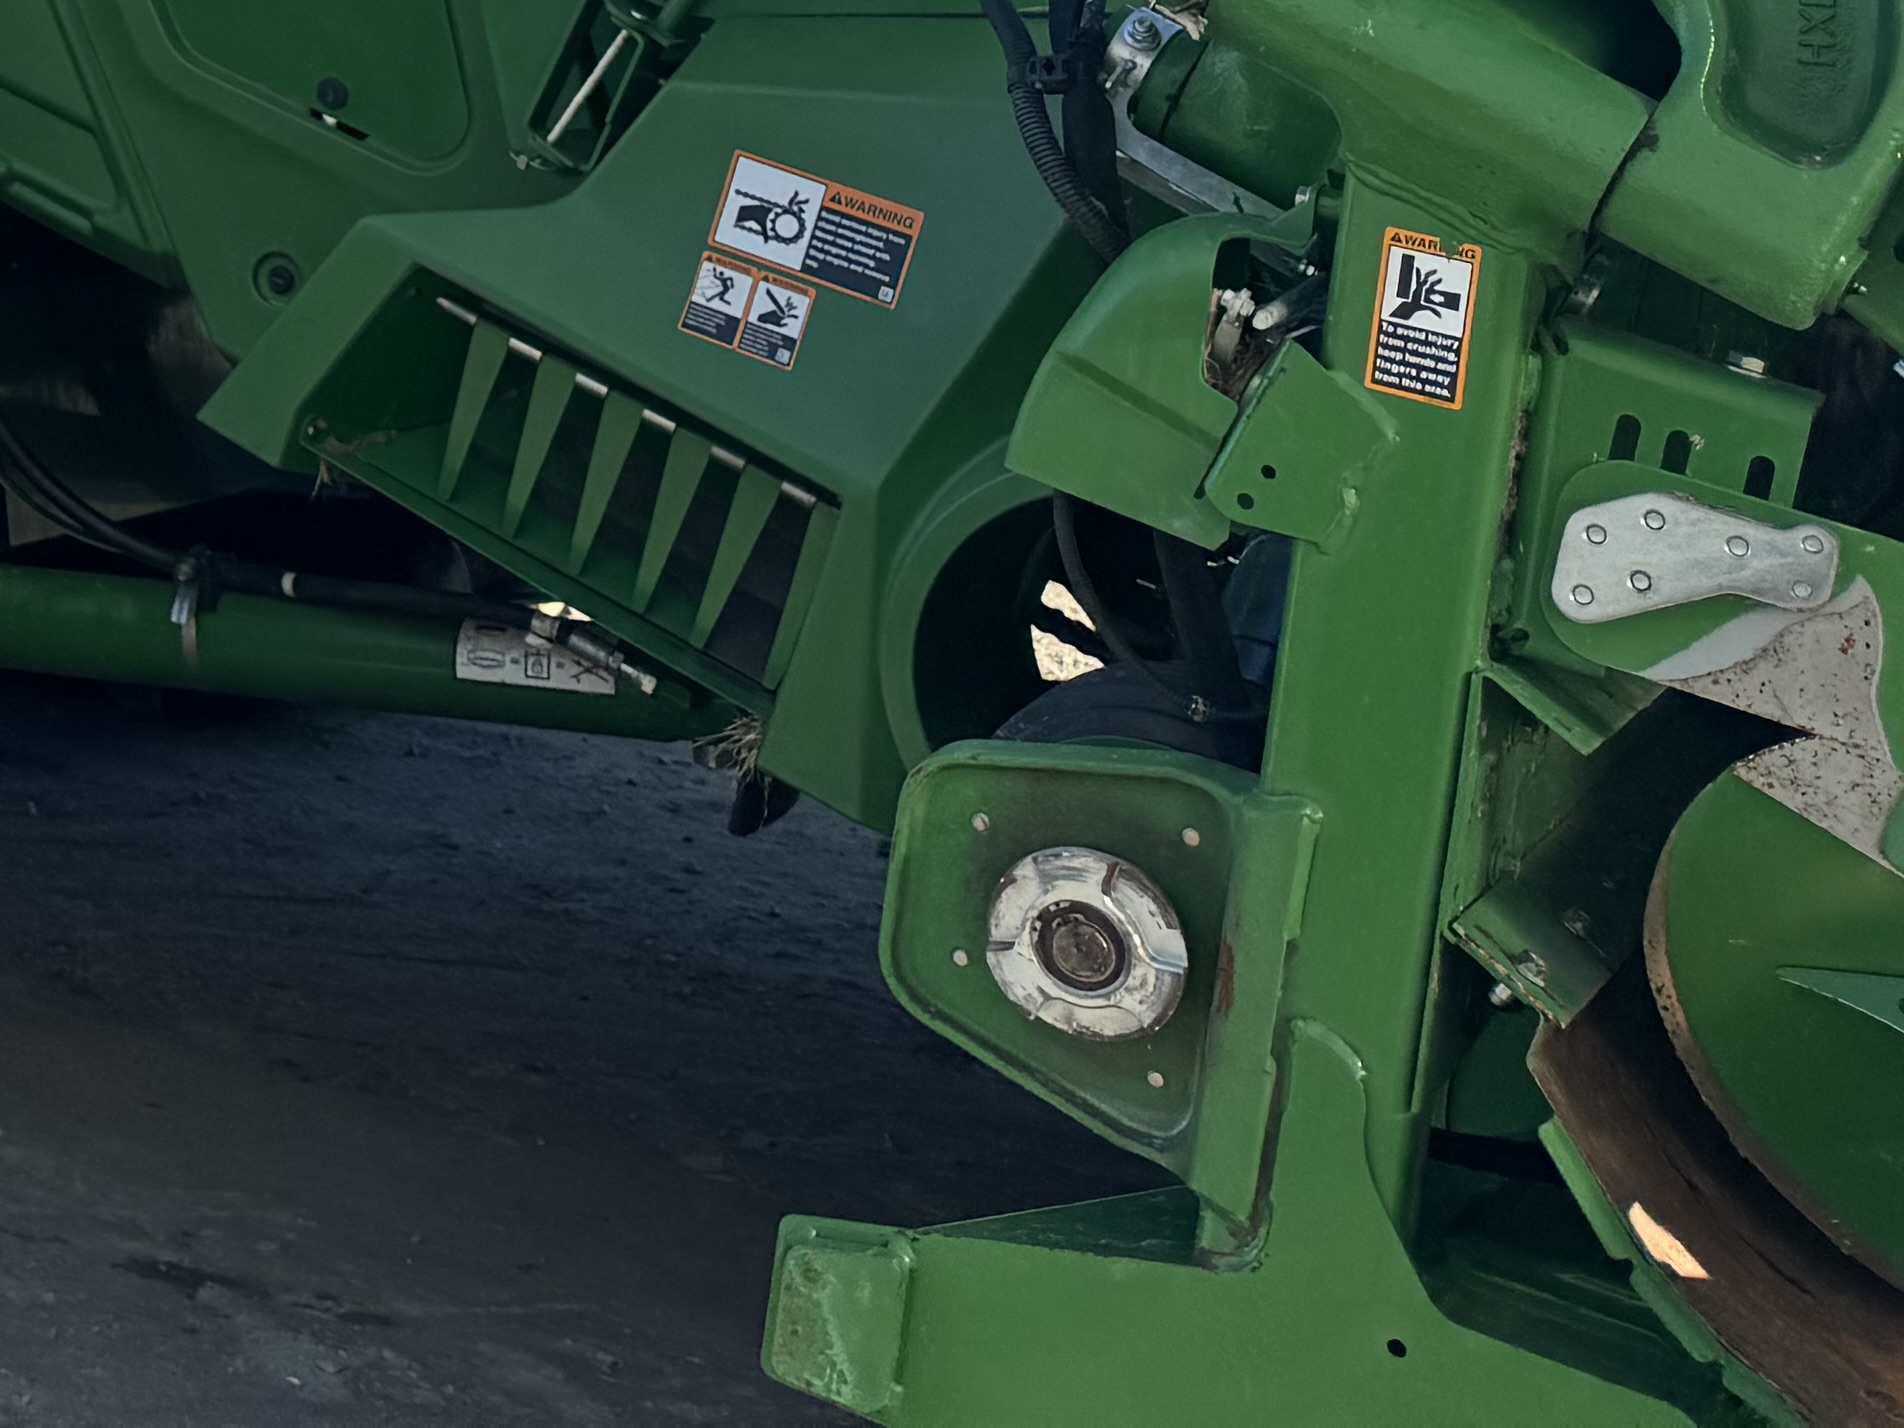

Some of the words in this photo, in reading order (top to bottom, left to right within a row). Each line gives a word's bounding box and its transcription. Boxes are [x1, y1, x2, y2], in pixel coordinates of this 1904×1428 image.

[844, 196, 916, 229] WARNING
[1381, 321, 1394, 333] To
[1396, 327, 1426, 341] avoid
[1379, 334, 1405, 348] from
[1420, 370, 1451, 386] away
